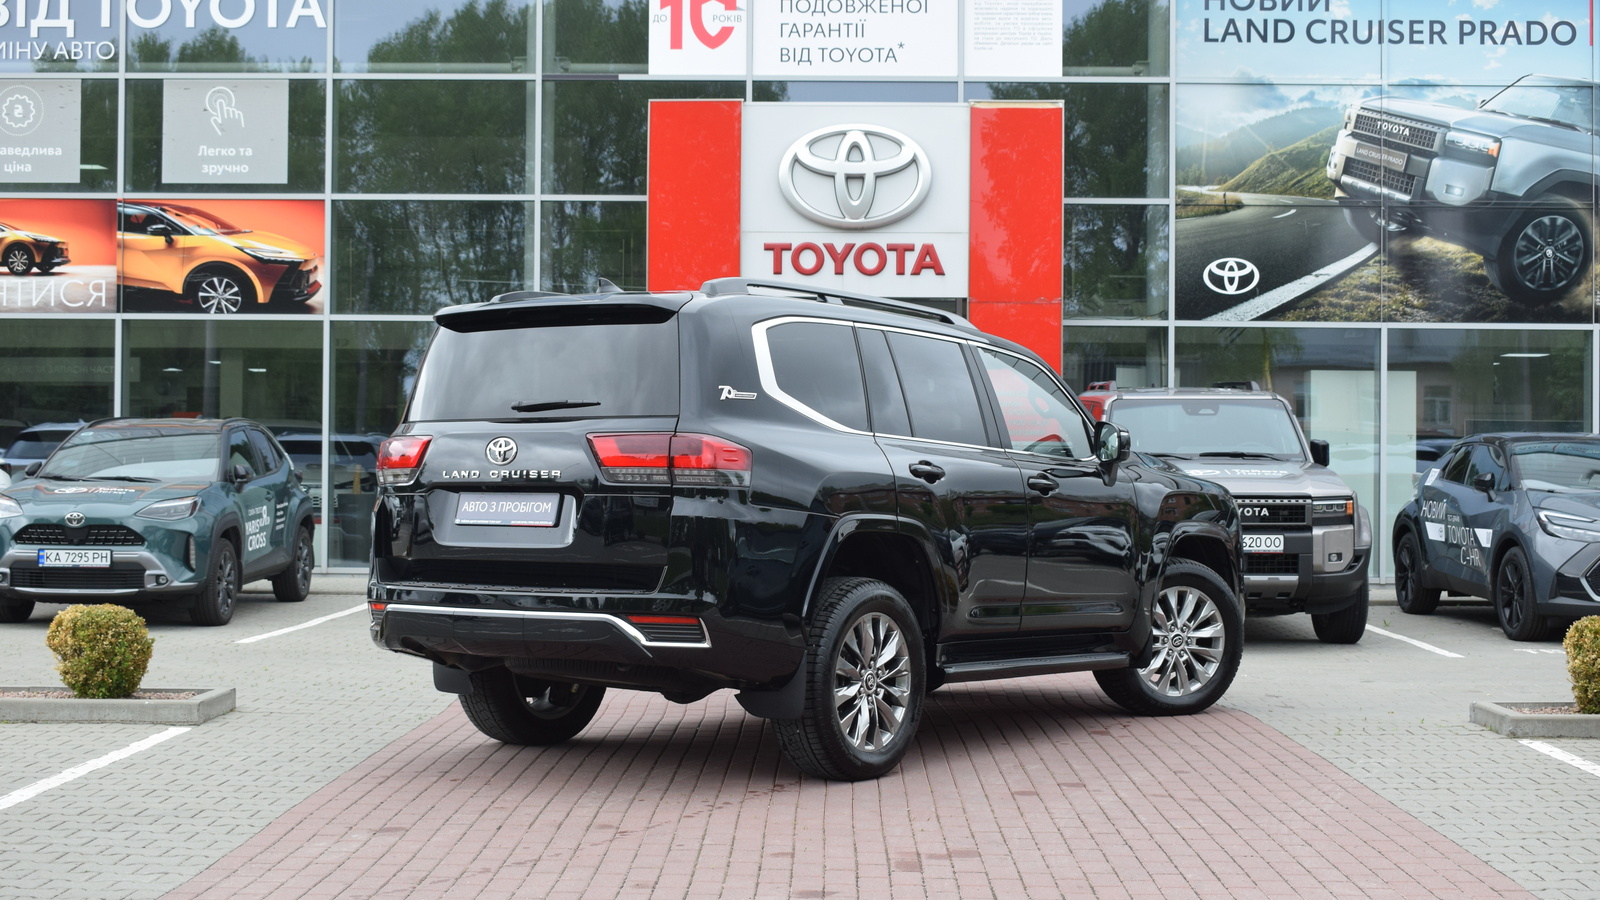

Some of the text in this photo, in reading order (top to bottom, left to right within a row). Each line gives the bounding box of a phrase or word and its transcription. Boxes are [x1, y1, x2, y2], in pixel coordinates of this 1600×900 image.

[652, 14, 667, 23] ДО
[712, 15, 743, 23] РОКІВ
[780, 19, 865, 38] ГАРАНТІЇ
[1203, 18, 1577, 46] LAND CRUISER PRADO
[53, 41, 115, 60] АВТО
[780, 47, 812, 66] ВІД
[1377, 121, 1410, 136] TOYOTA
[197, 145, 253, 158] Легко та
[4, 161, 32, 174] ціна
[201, 164, 249, 176] зручно
[763, 242, 946, 276] TOYOTA
[442, 469, 562, 479] LAND CRUISER
[462, 501, 488, 512] АВТО
[498, 502, 552, 513] ПРОБІГОМ
[1420, 499, 1447, 520] НОВИЙ
[245, 518, 260, 536] YARIS
[1447, 525, 1476, 547] TOYOTA
[248, 531, 267, 551] CROSS
[45, 552, 61, 563] KA
[65, 552, 89, 563] 7295
[1460, 546, 1482, 567] C-HR
